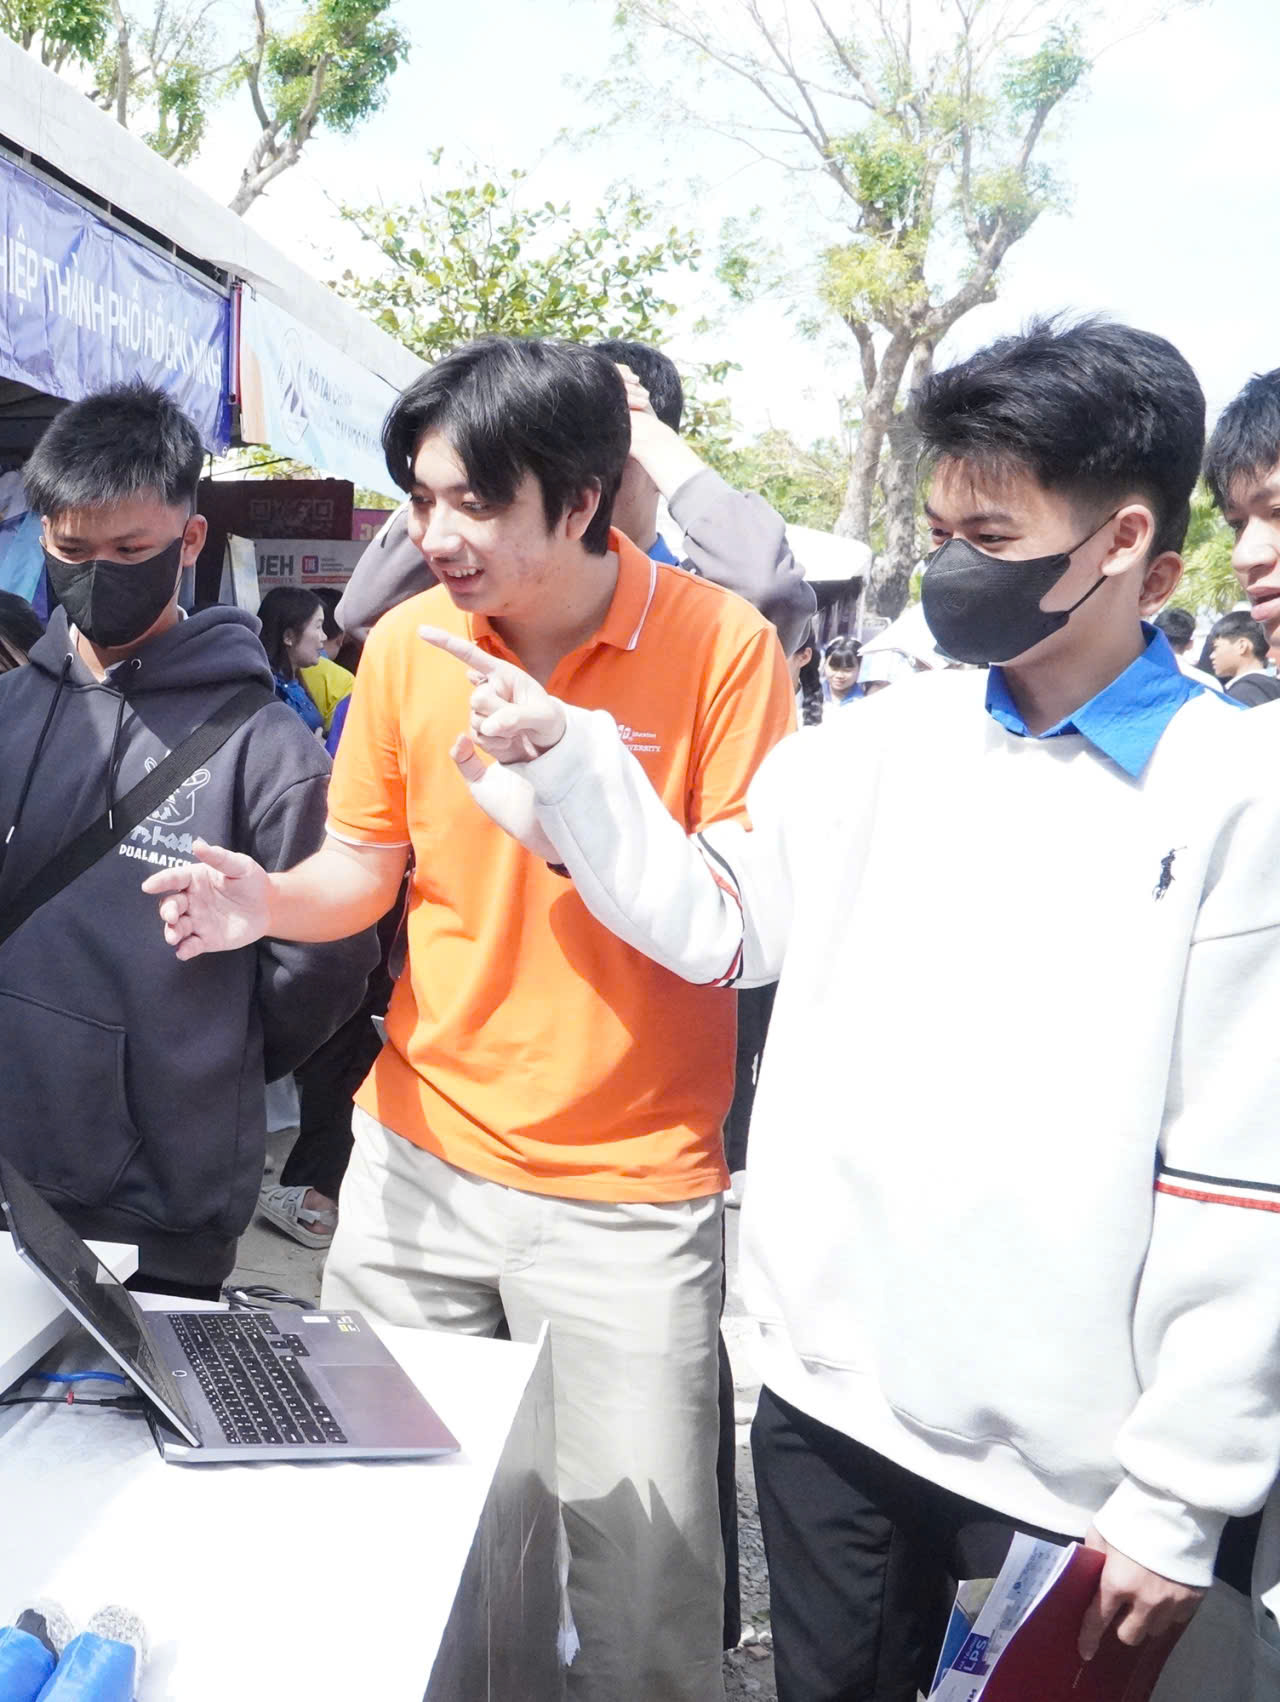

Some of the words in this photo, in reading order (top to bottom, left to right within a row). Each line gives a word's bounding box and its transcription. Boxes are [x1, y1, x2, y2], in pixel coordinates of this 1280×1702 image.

[42, 253, 105, 334] THÀNH
[109, 280, 141, 351] PHỐ
[144, 294, 165, 362] HỒ
